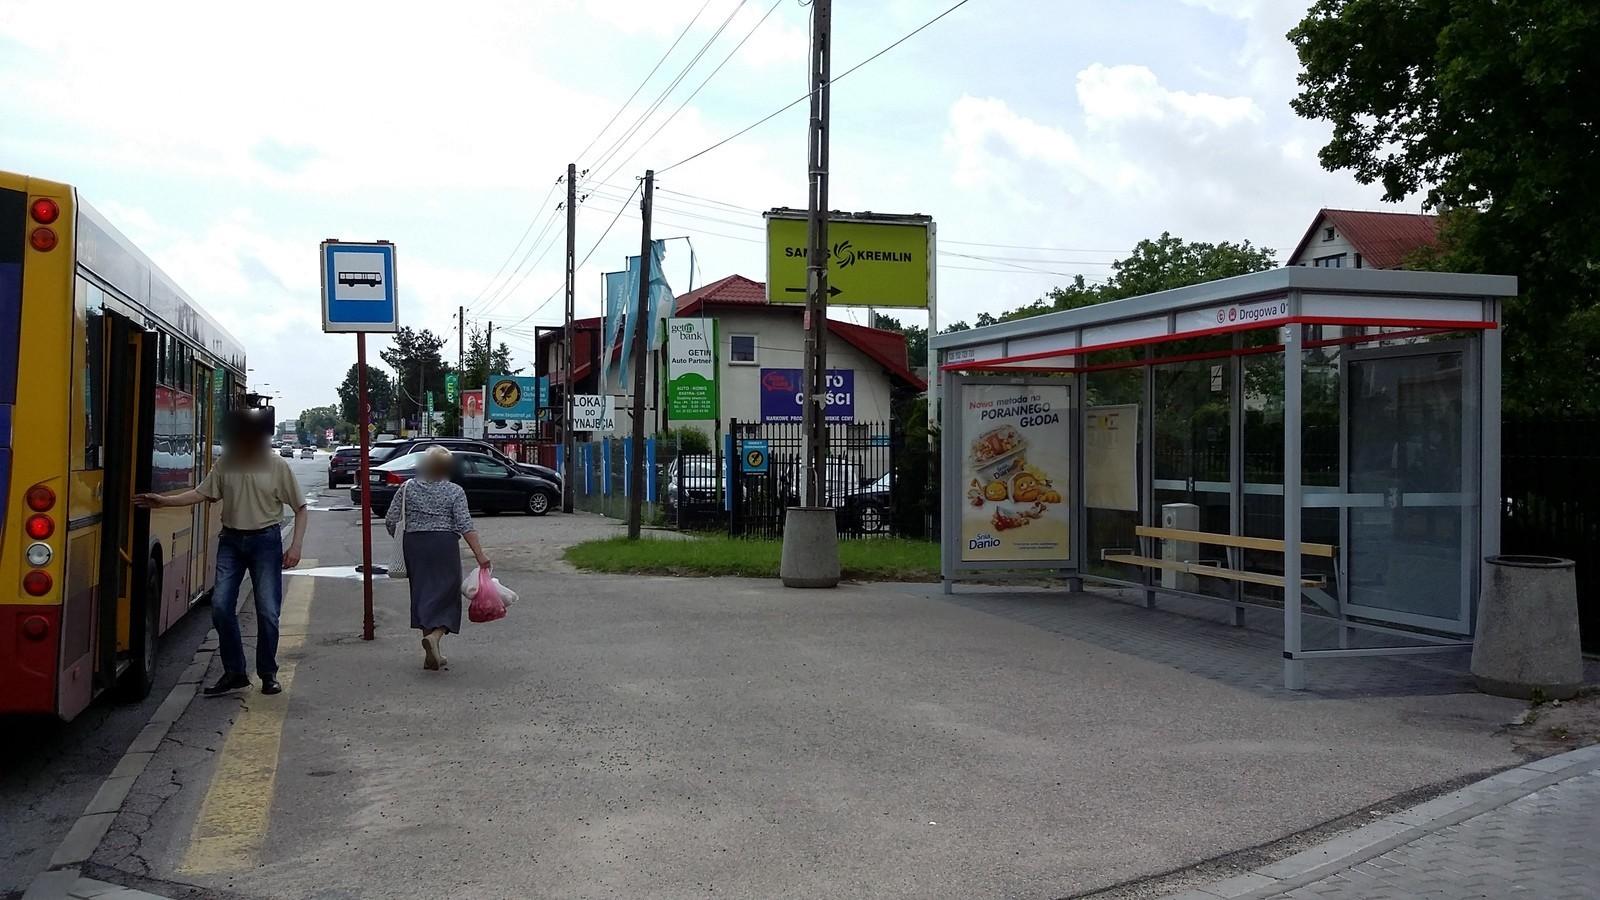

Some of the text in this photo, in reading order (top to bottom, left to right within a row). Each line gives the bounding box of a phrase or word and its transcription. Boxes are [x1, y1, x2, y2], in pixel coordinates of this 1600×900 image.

[857, 250, 912, 262] KREMLIN
[1240, 306, 1277, 321] Drogowa
[680, 332, 703, 341] bank
[688, 349, 712, 357] GETIN
[795, 390, 851, 405] CŚCI
[969, 401, 993, 410] Nowa
[996, 395, 1028, 406] metoda
[981, 402, 1051, 421] PORANNEGO
[1020, 413, 1059, 428] GŁODA
[969, 537, 1000, 550] Danio
